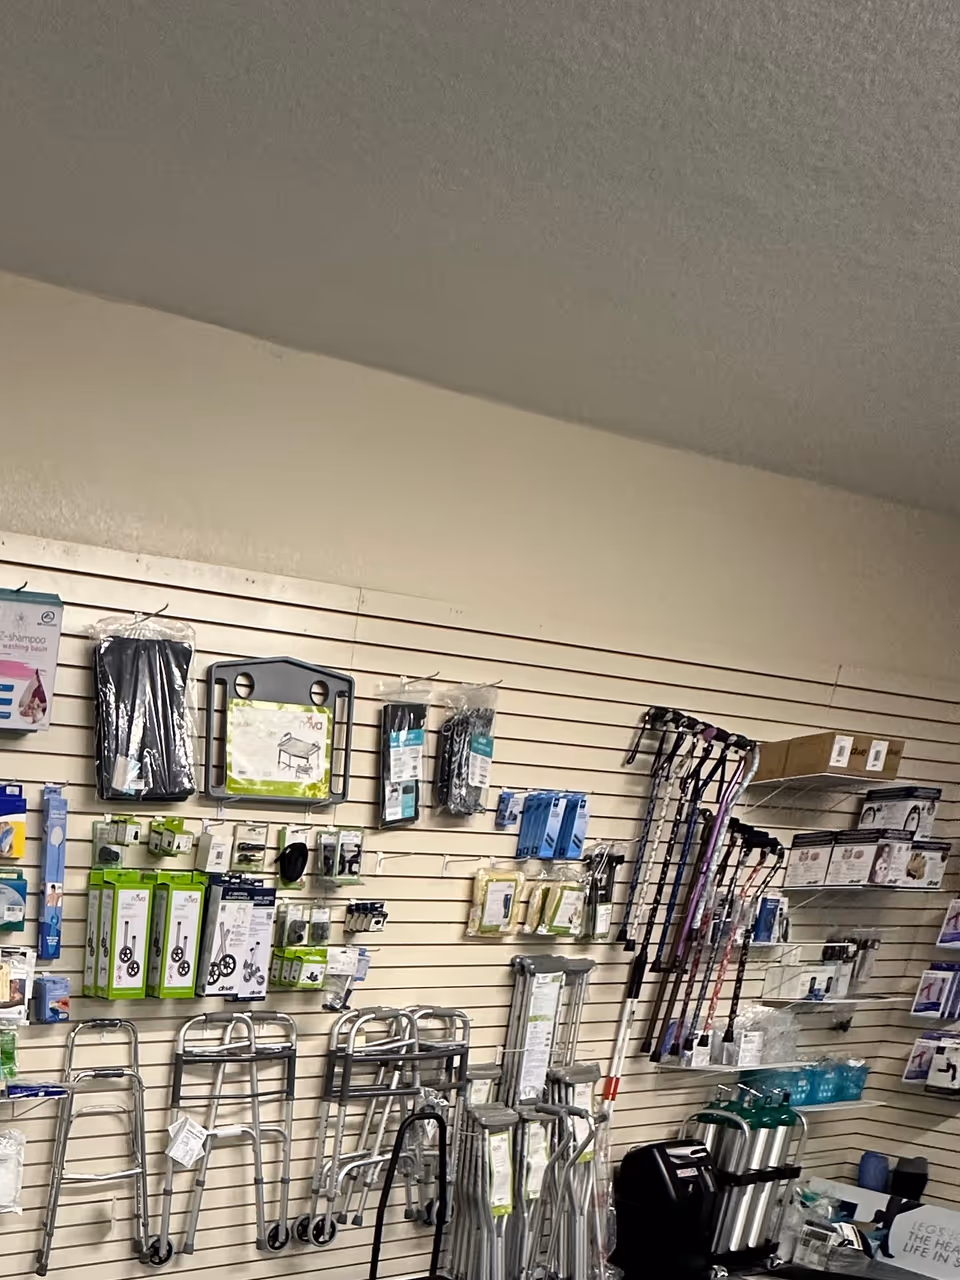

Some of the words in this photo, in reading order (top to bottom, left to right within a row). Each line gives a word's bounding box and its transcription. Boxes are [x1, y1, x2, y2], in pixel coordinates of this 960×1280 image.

[909, 1231, 931, 1246] THE
[903, 1242, 930, 1258] LIFE
[933, 1251, 950, 1263] IN
